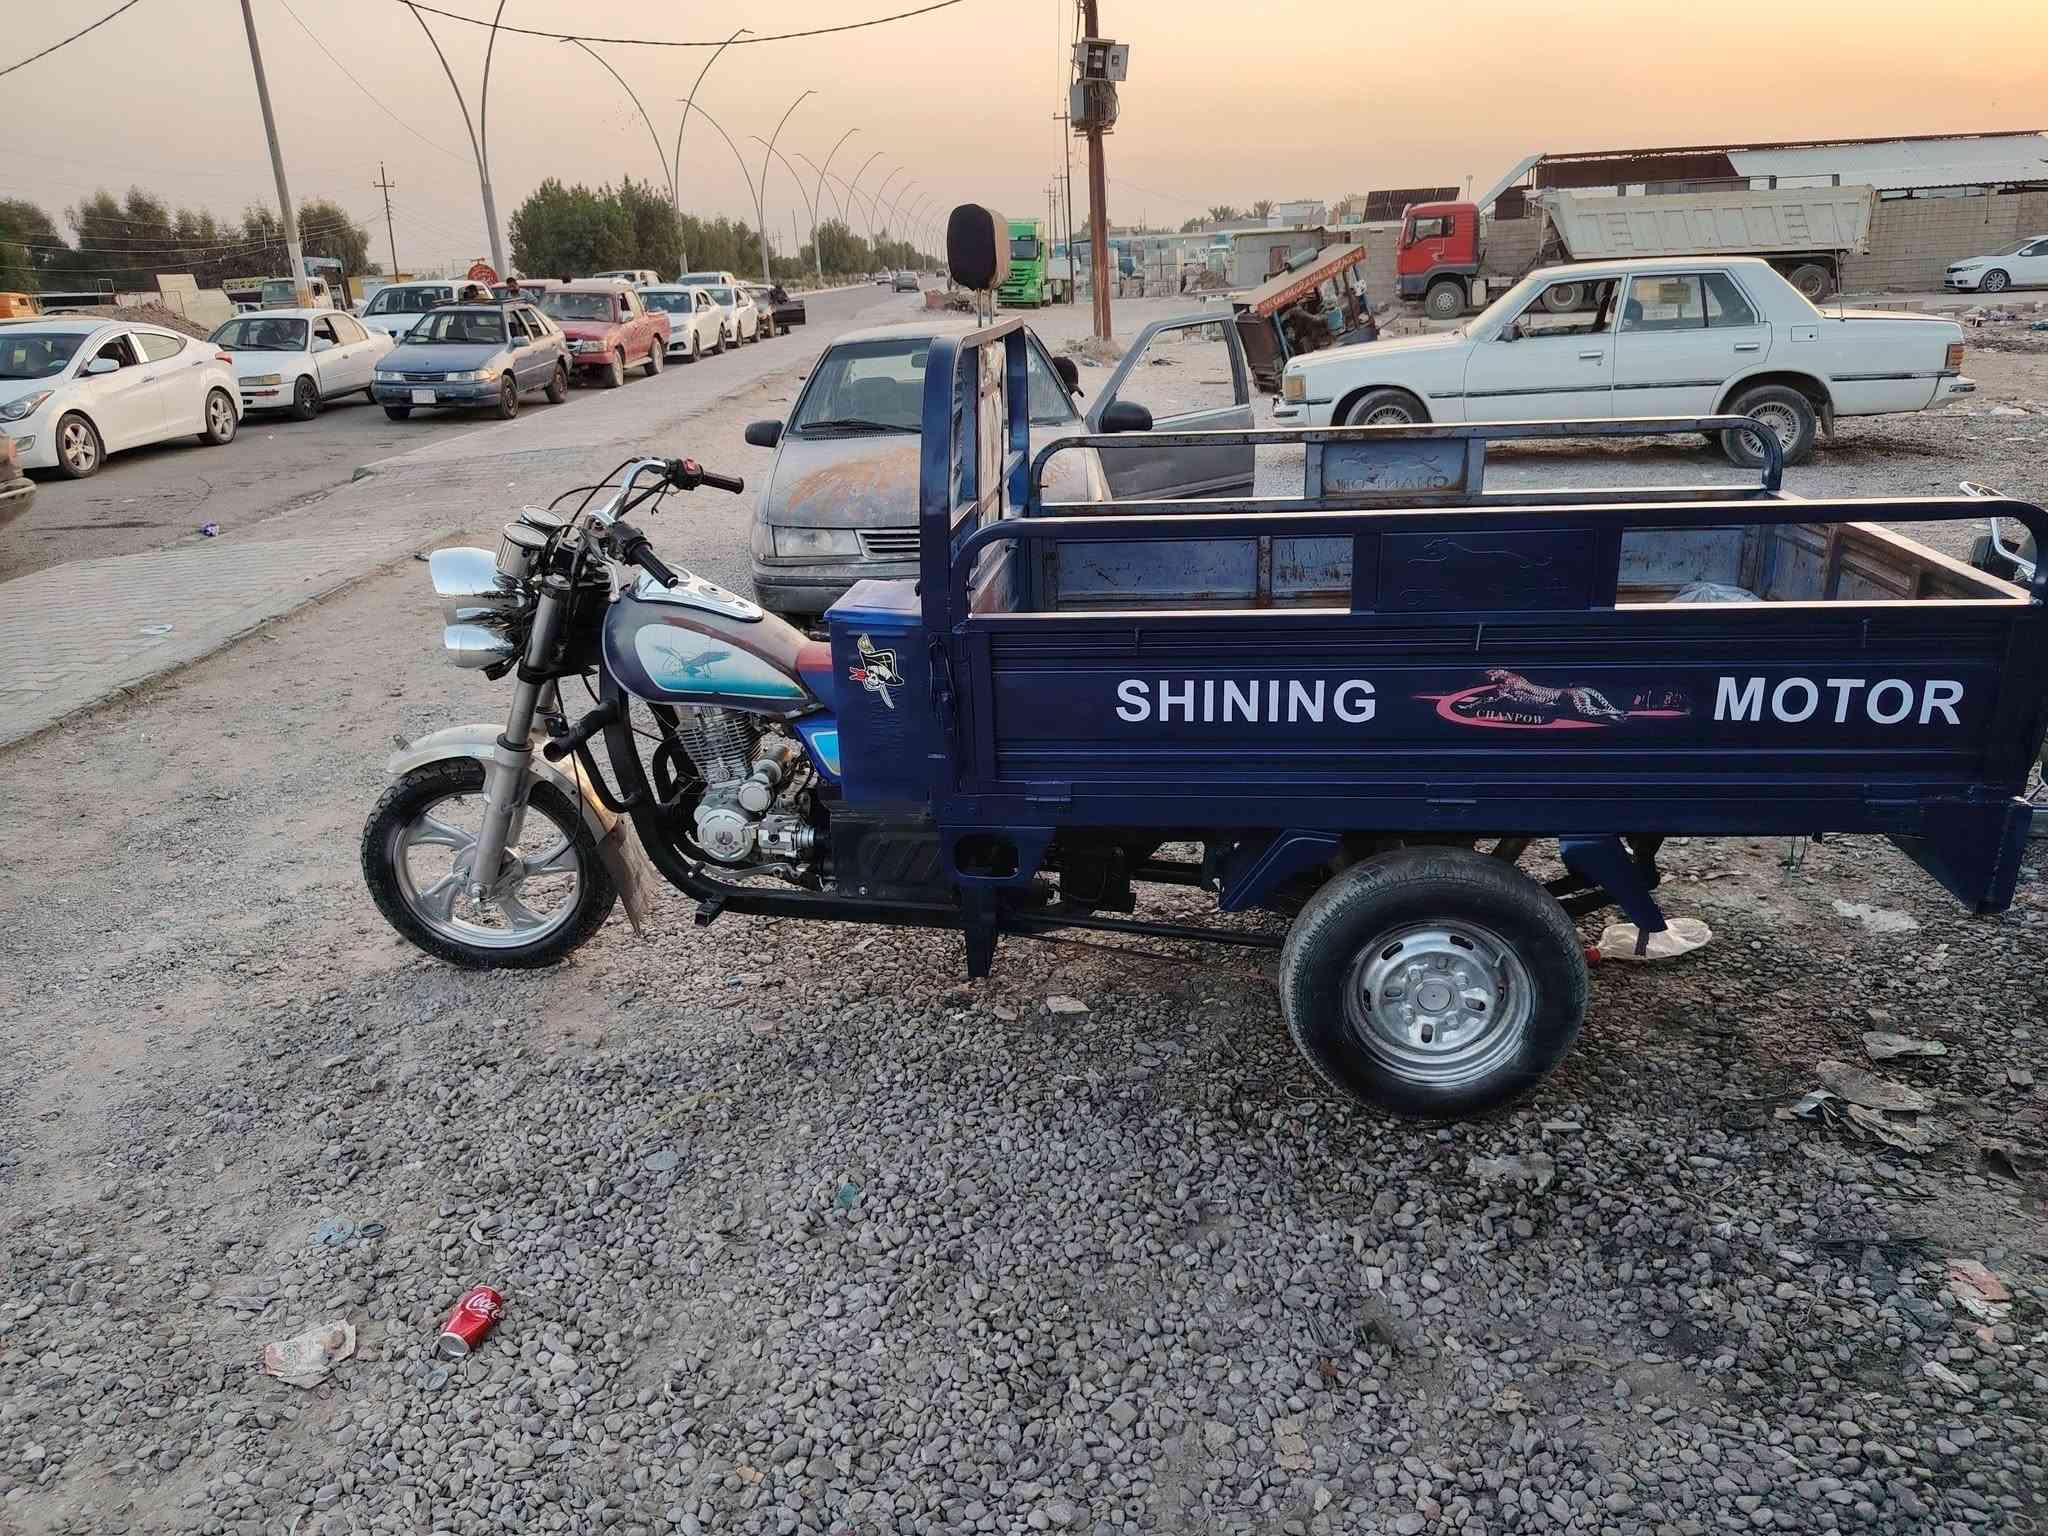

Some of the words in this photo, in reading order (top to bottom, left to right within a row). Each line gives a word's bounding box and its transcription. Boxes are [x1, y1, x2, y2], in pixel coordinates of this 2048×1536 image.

[1116, 679, 1376, 723] SHINING
[1713, 677, 1964, 725] MOTOR
[1476, 709, 1545, 725] CHANPOW
